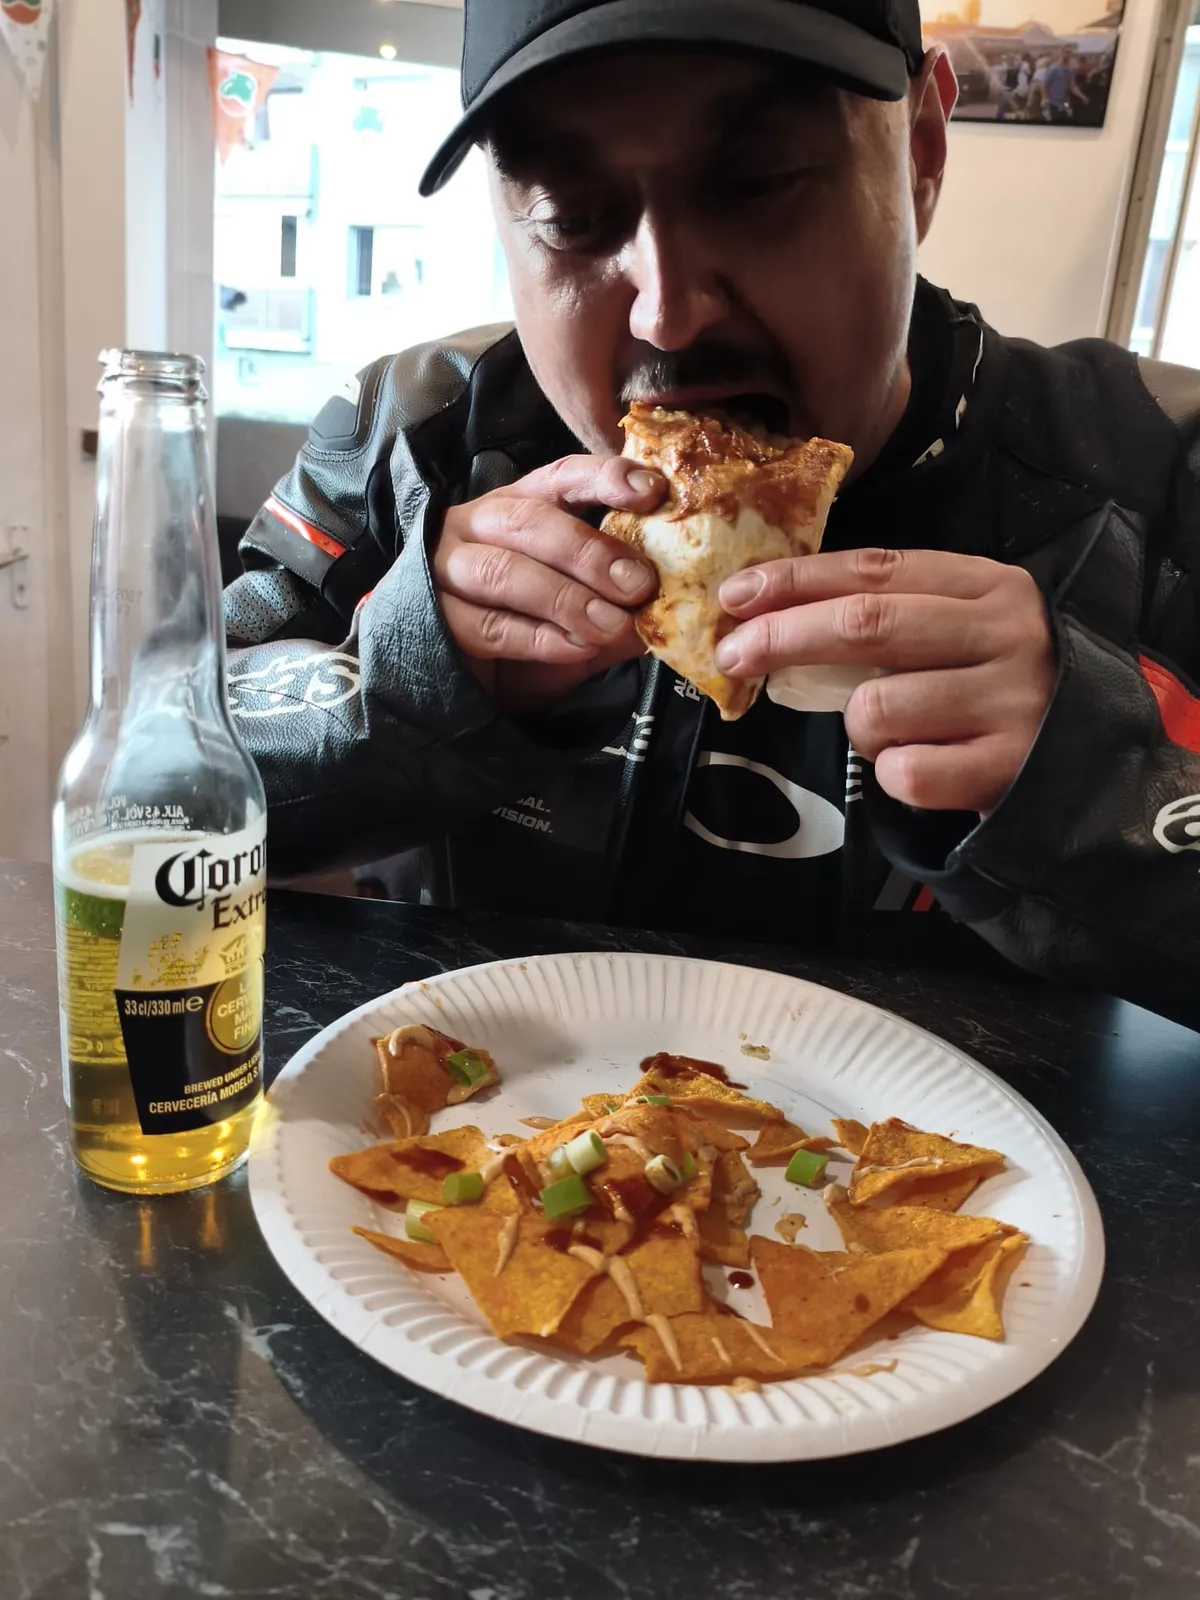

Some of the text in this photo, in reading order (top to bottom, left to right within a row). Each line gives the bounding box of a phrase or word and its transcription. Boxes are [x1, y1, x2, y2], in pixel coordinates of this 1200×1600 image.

[234, 1019, 252, 1041] FIN
[184, 1076, 223, 1095] BREWED
[224, 1062, 248, 1082] UNDER
[149, 1086, 218, 1114] CERVECERÍA
